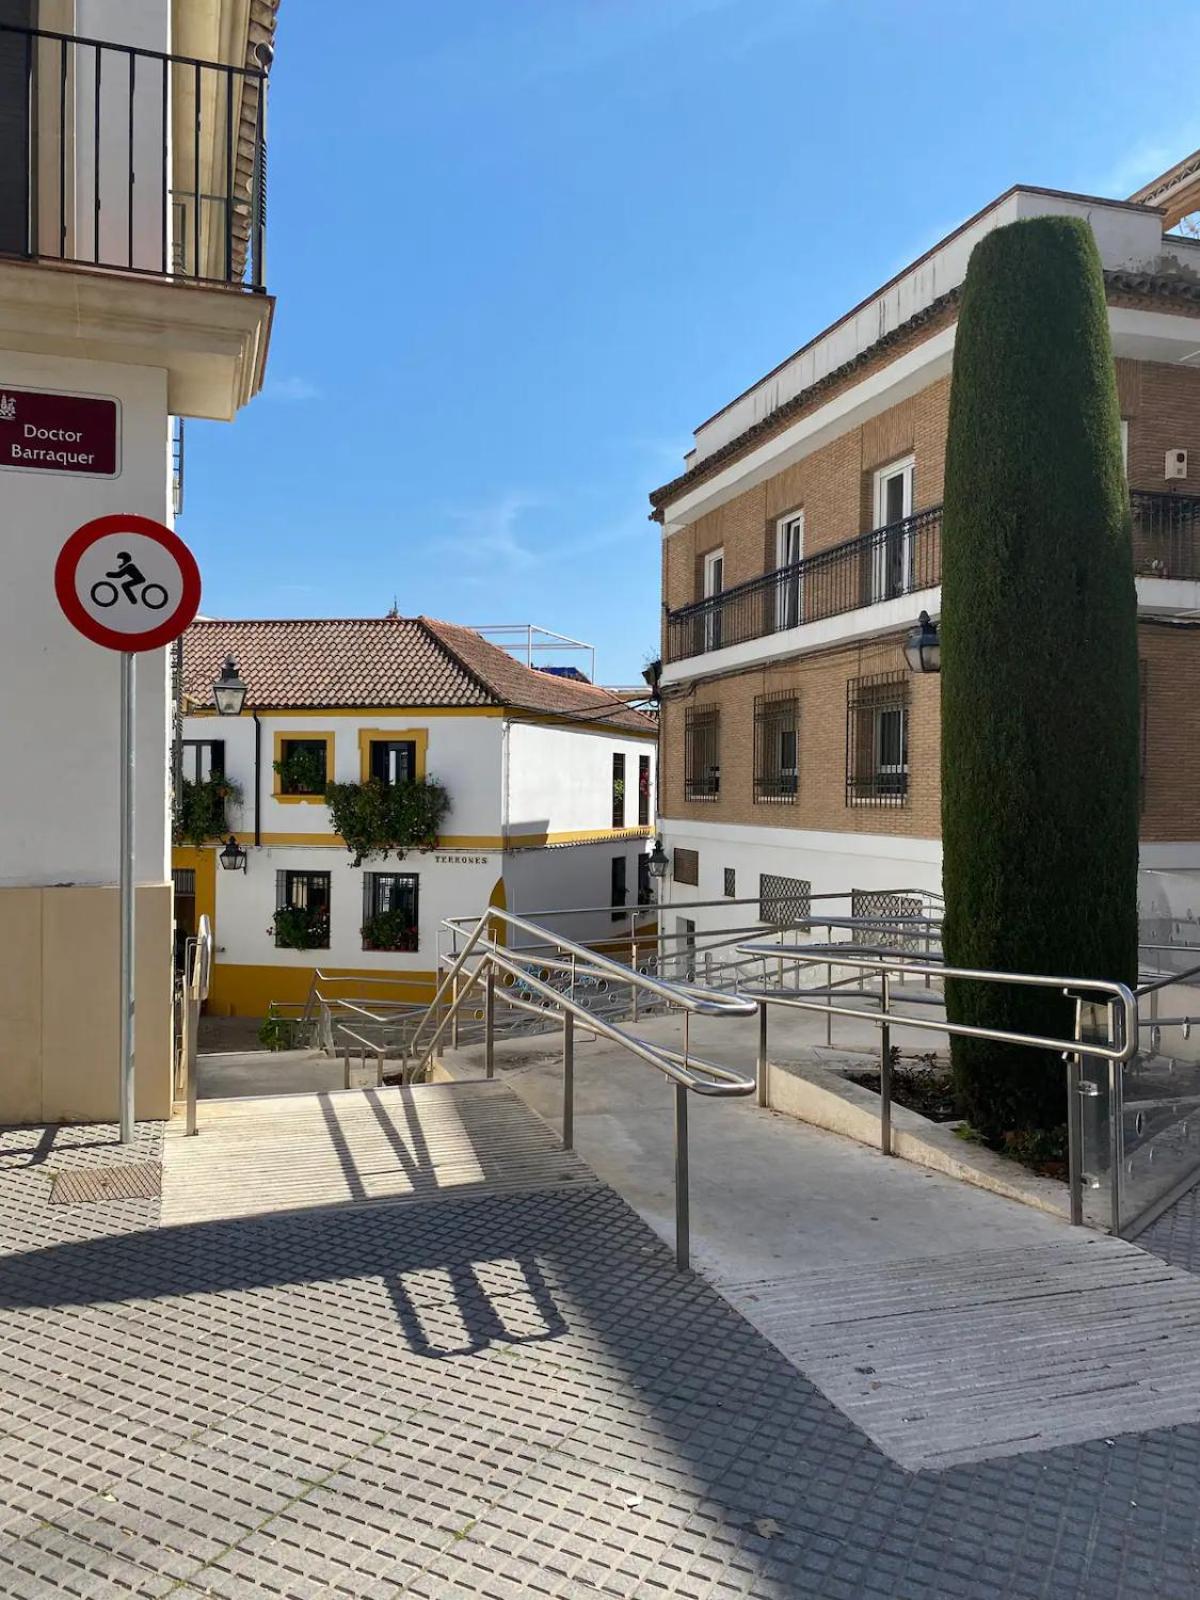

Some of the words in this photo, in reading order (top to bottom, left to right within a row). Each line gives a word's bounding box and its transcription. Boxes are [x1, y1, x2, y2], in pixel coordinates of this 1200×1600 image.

[23, 424, 83, 442] Doctor
[11, 444, 95, 465] Barraquer
[435, 855, 488, 864] TERRONES
